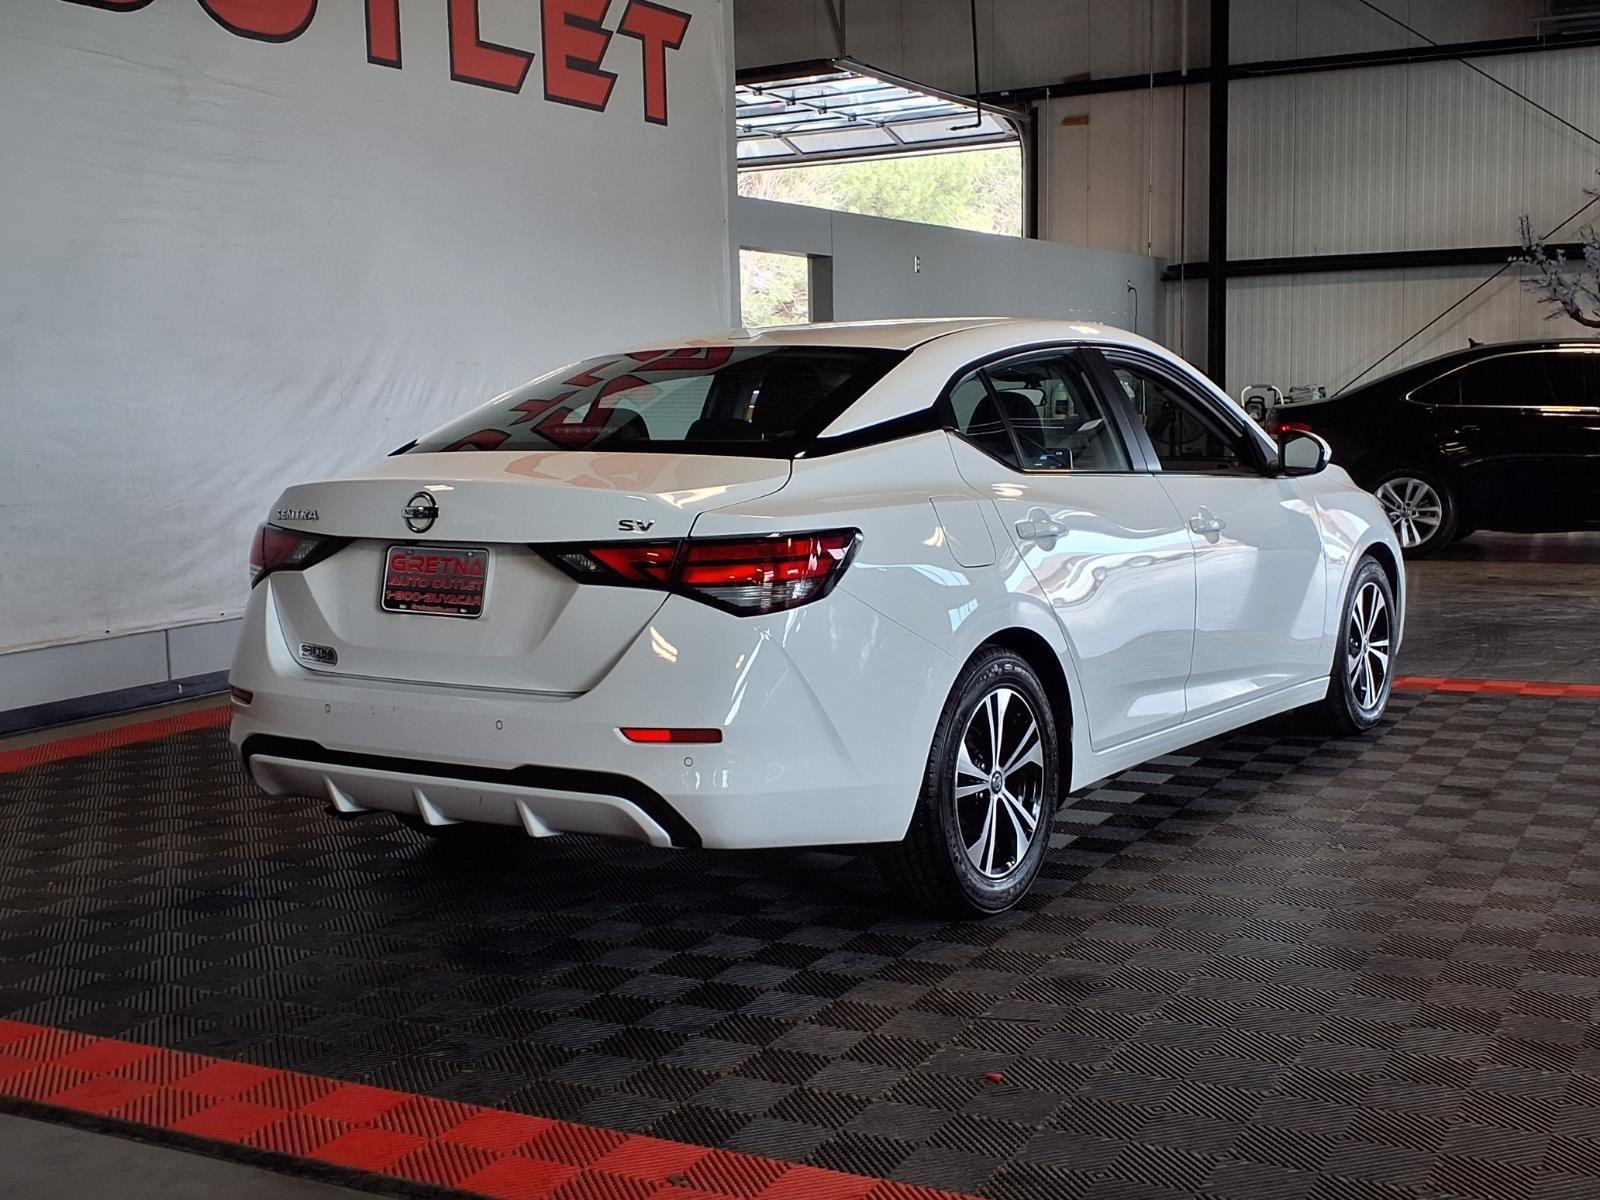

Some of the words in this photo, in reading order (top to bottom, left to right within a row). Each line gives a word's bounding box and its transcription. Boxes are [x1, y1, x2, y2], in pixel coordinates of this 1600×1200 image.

[57, 0, 691, 127] LET
[276, 509, 318, 521] SENTRA
[617, 519, 656, 532] SV
[391, 553, 484, 577] GRETNA
[389, 575, 429, 588] AUTO
[431, 577, 483, 590] OUTLET
[301, 644, 333, 656] GRETNA
